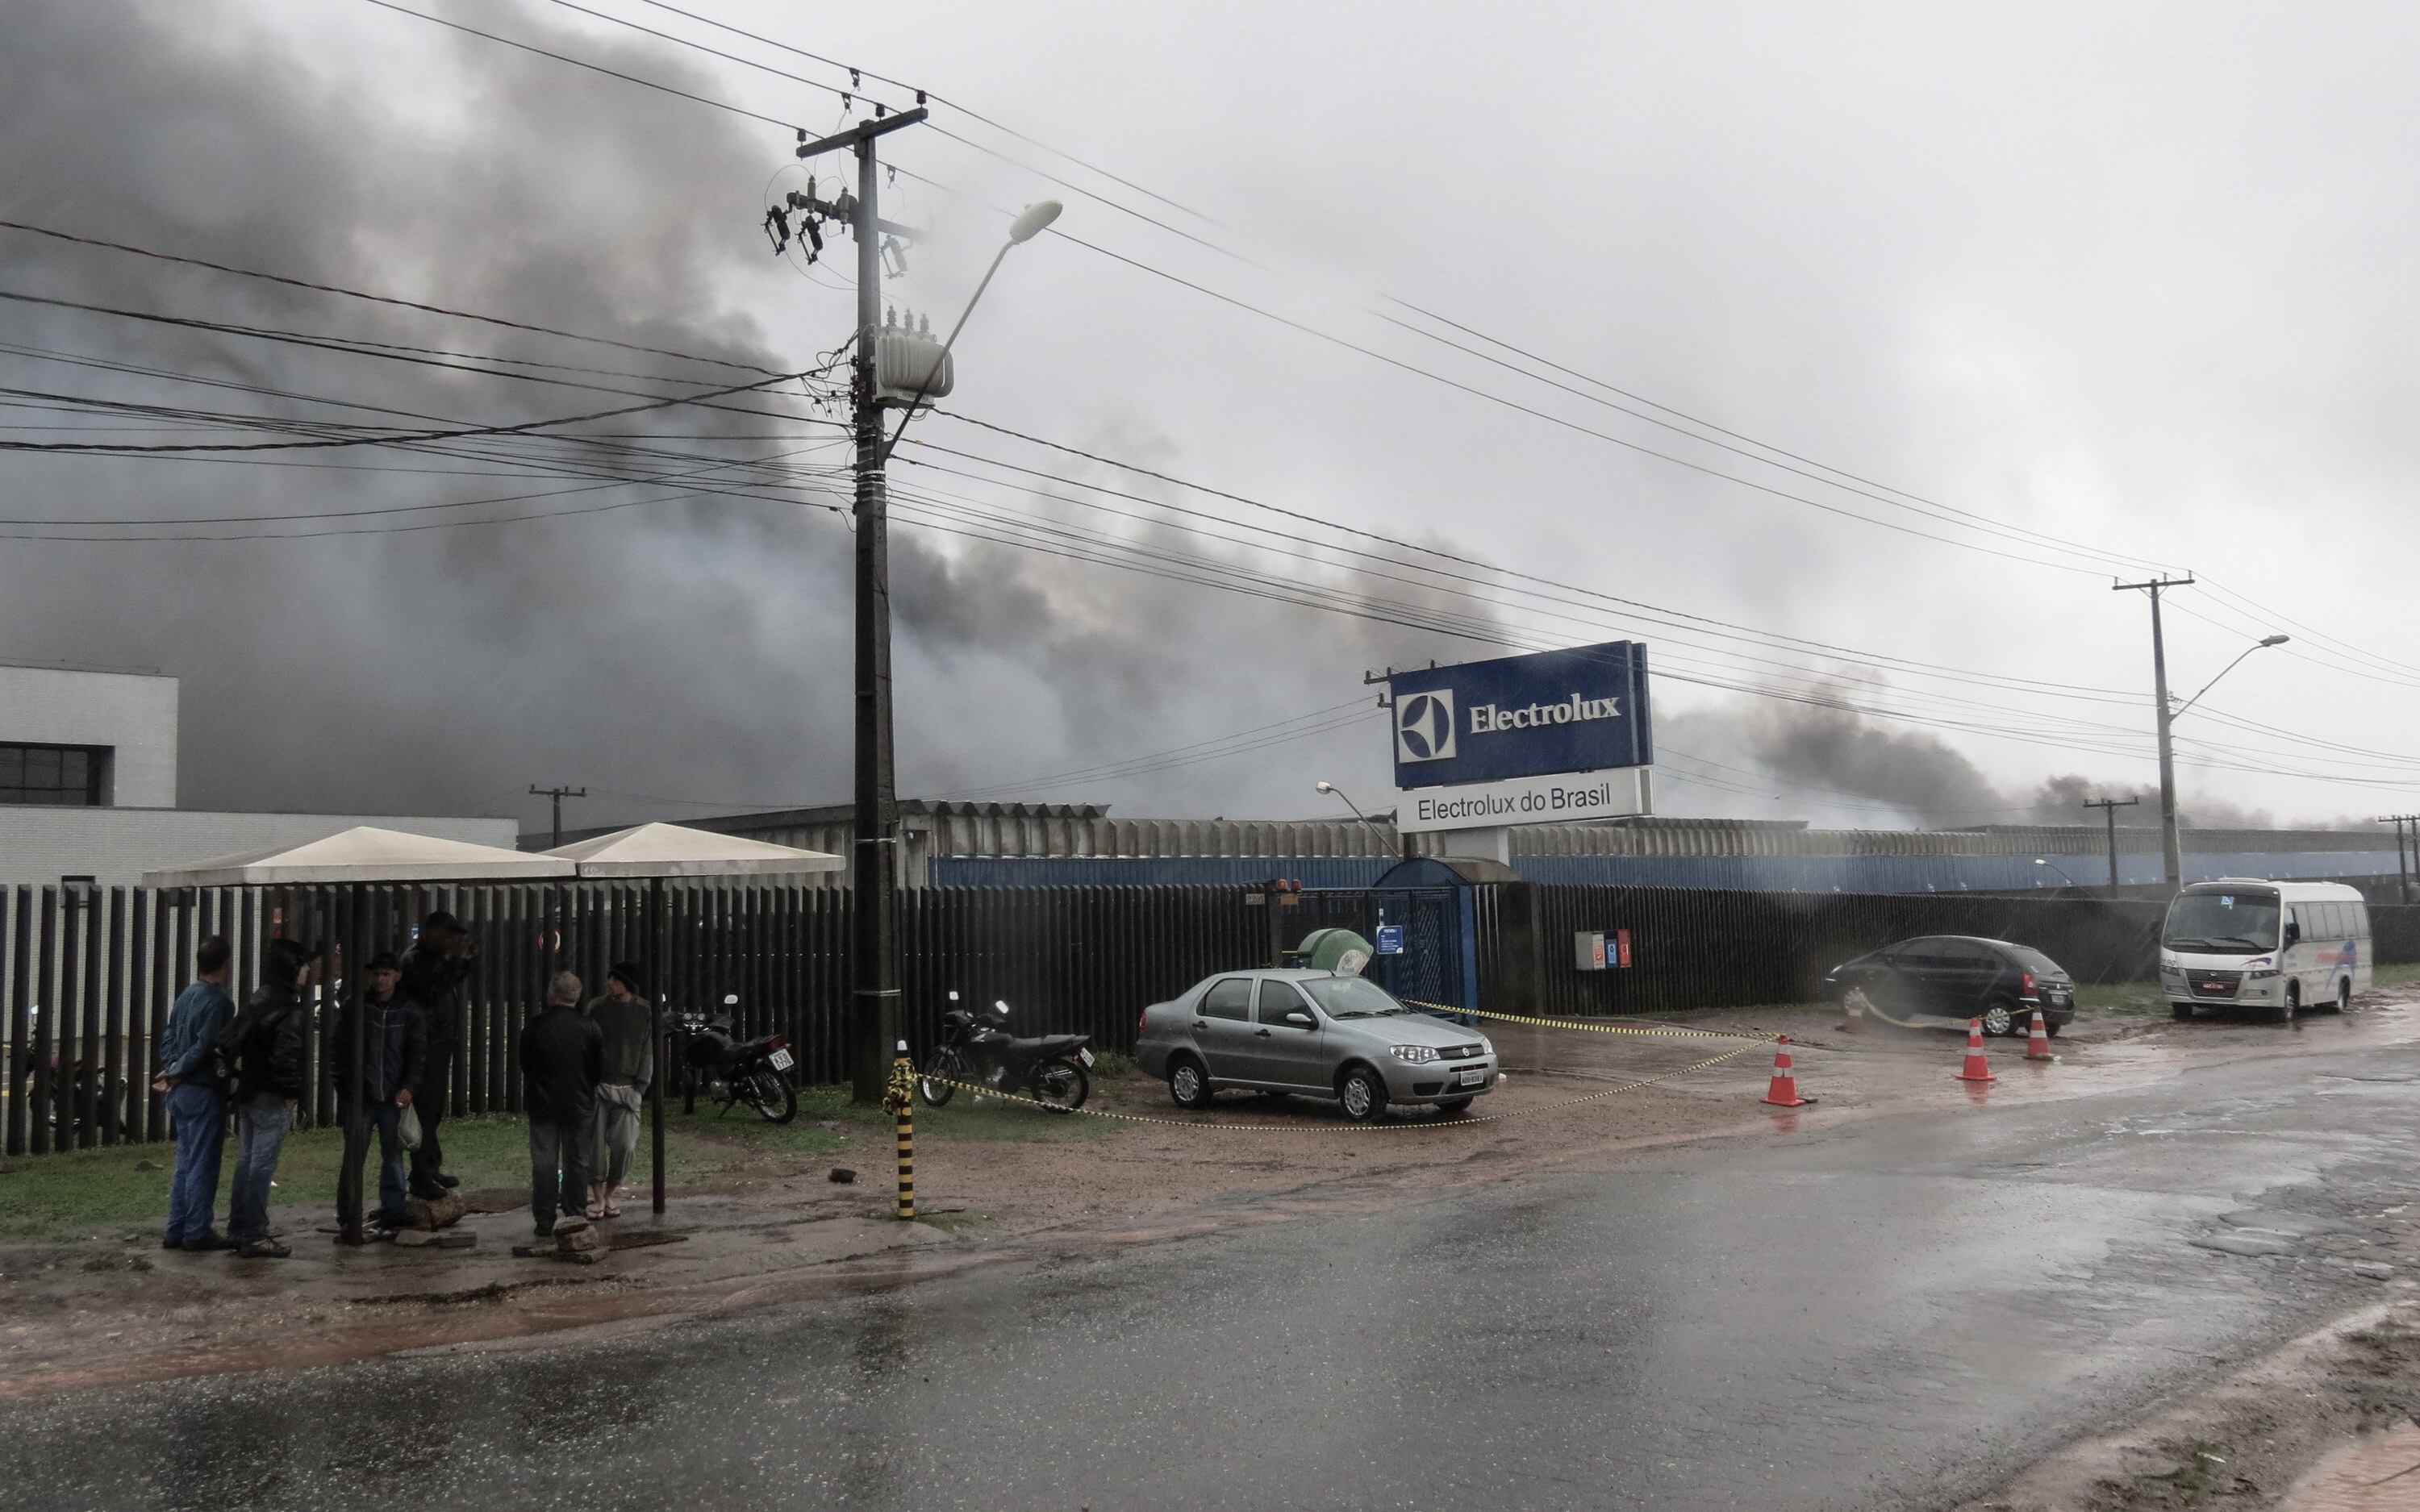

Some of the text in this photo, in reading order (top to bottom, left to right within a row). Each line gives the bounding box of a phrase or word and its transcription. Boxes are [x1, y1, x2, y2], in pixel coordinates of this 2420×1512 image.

[1470, 693, 1621, 733] Electrolux
[1418, 782, 1610, 820] Electrolux do Brasil
